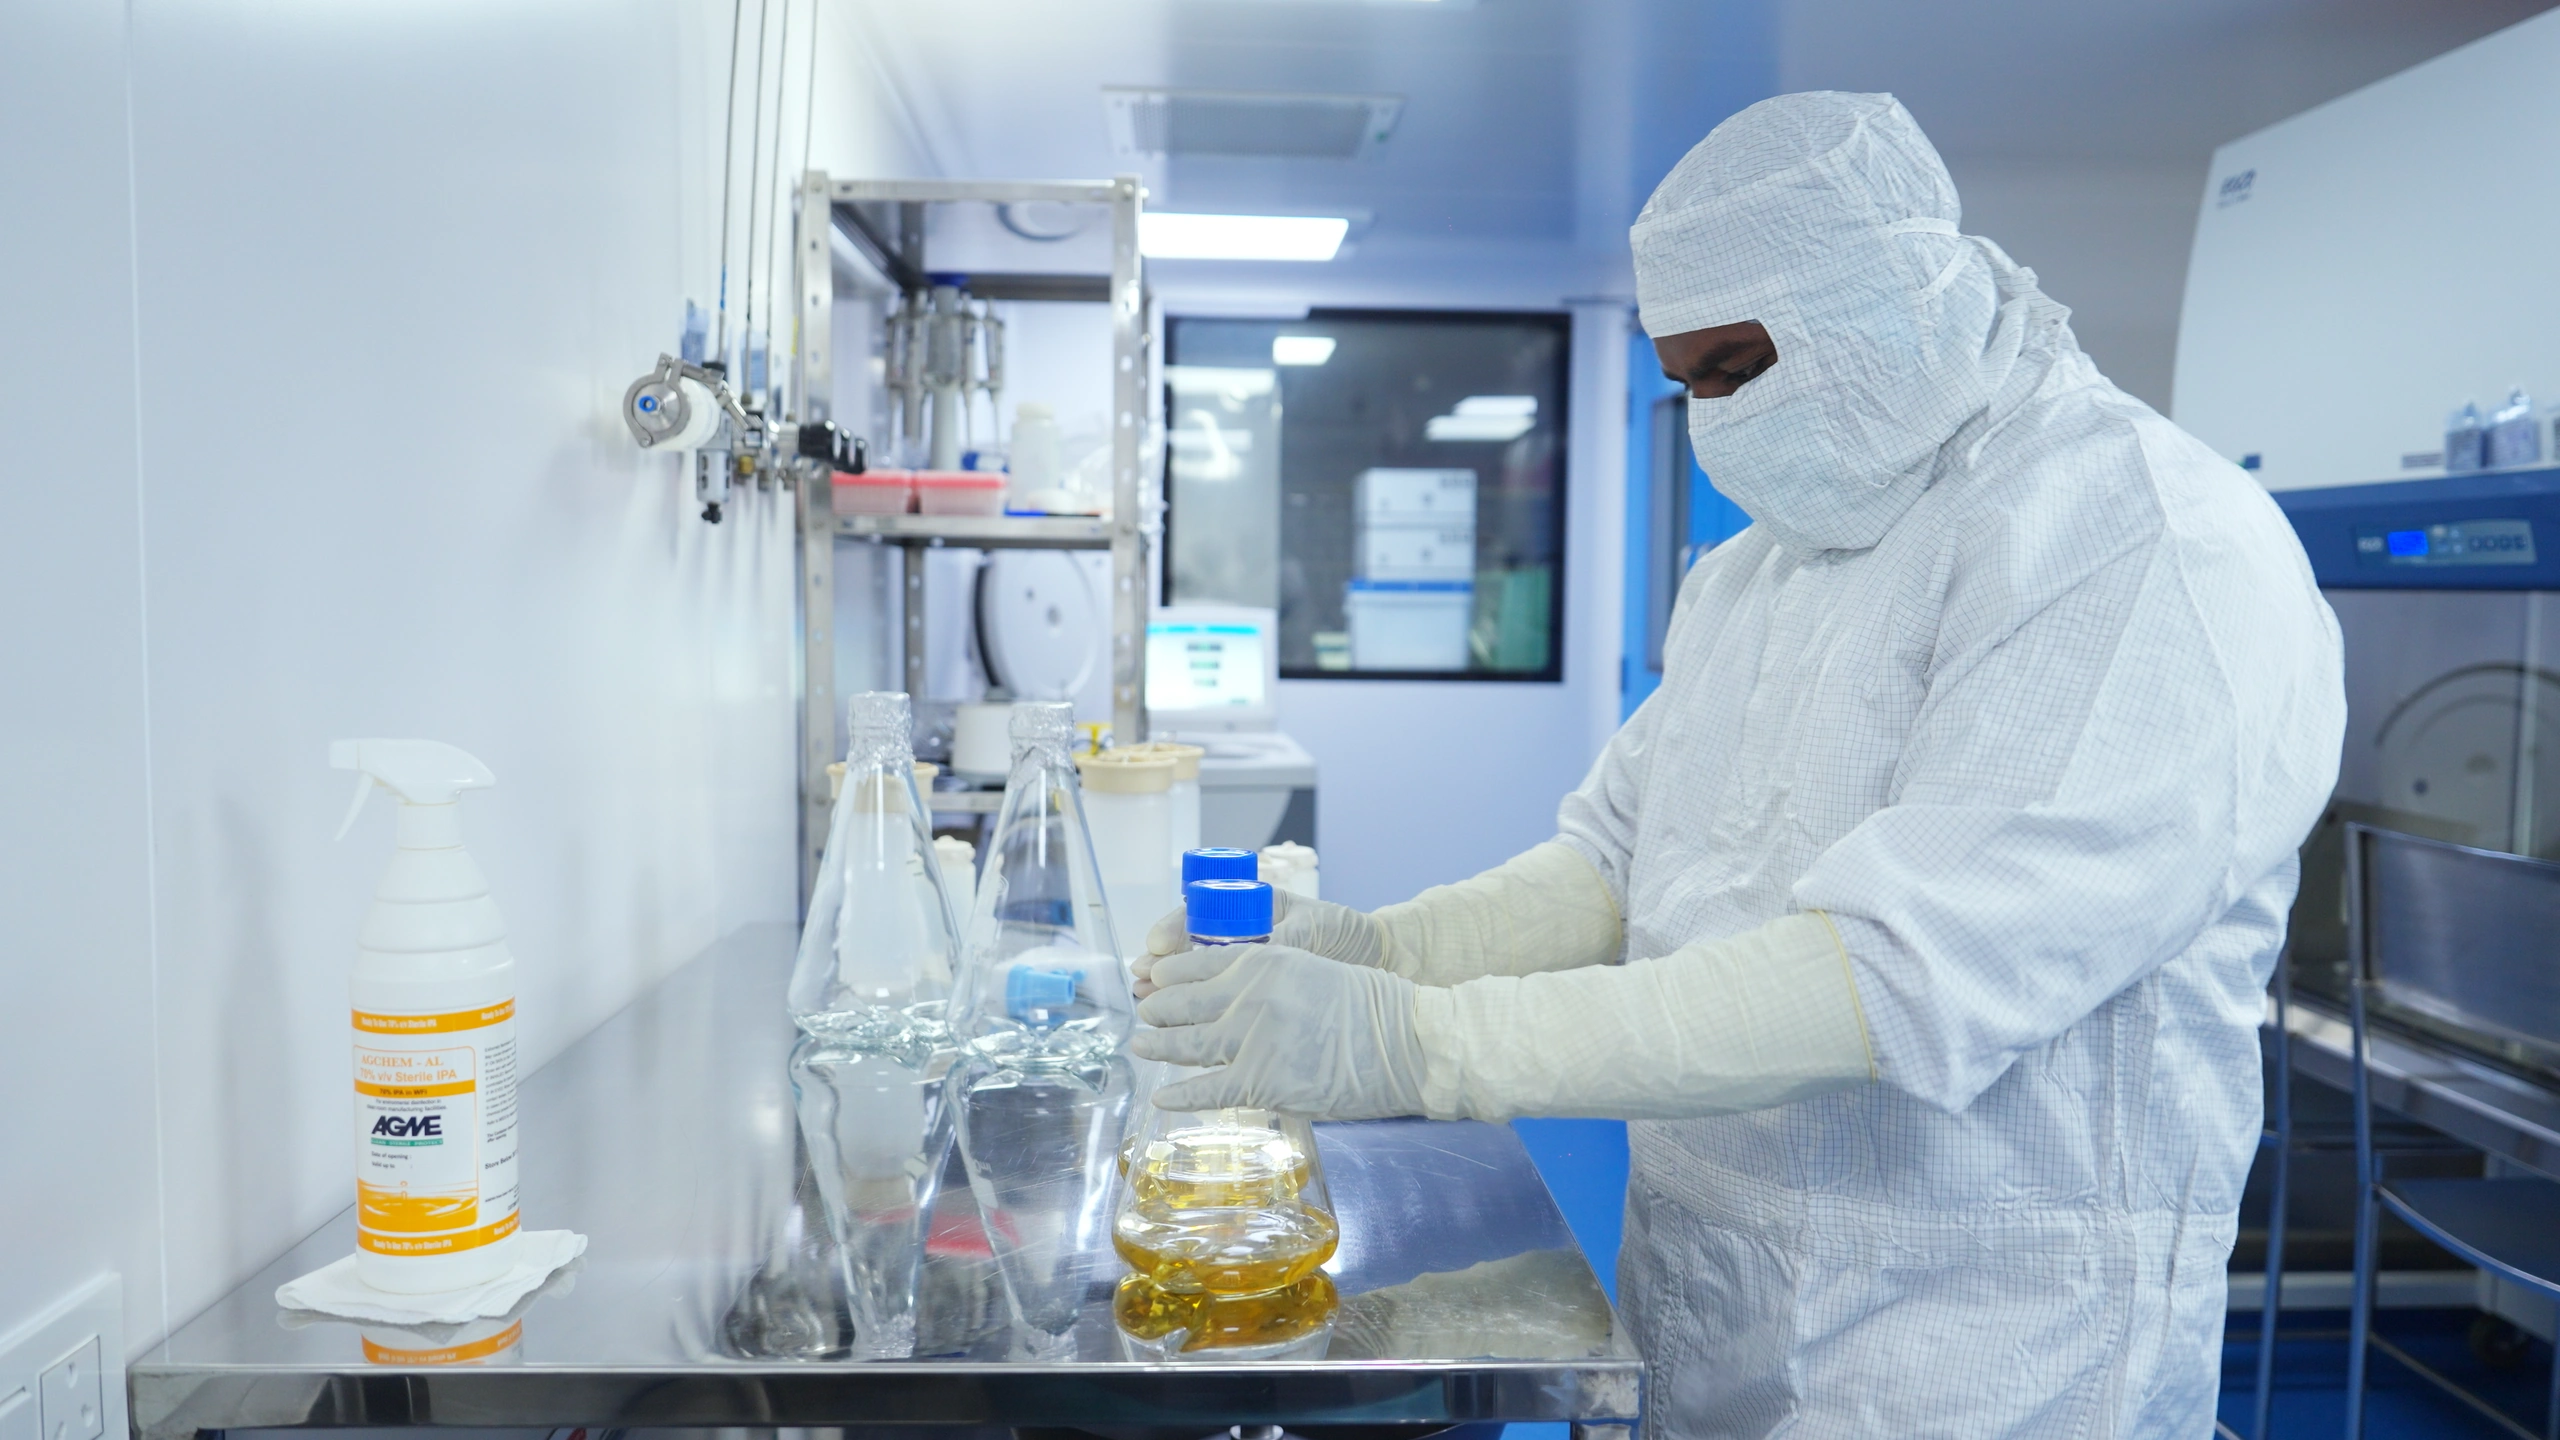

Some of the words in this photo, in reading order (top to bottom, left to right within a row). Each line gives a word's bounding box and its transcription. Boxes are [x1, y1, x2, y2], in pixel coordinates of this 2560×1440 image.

[361, 1055, 413, 1067] AGCHEM
[360, 1067, 376, 1080] 70%
[378, 1072, 392, 1082] v/v
[395, 1071, 433, 1082] Sterile
[437, 1069, 457, 1080] IPA
[371, 1115, 442, 1136] AGME
[485, 1161, 499, 1169] Store
